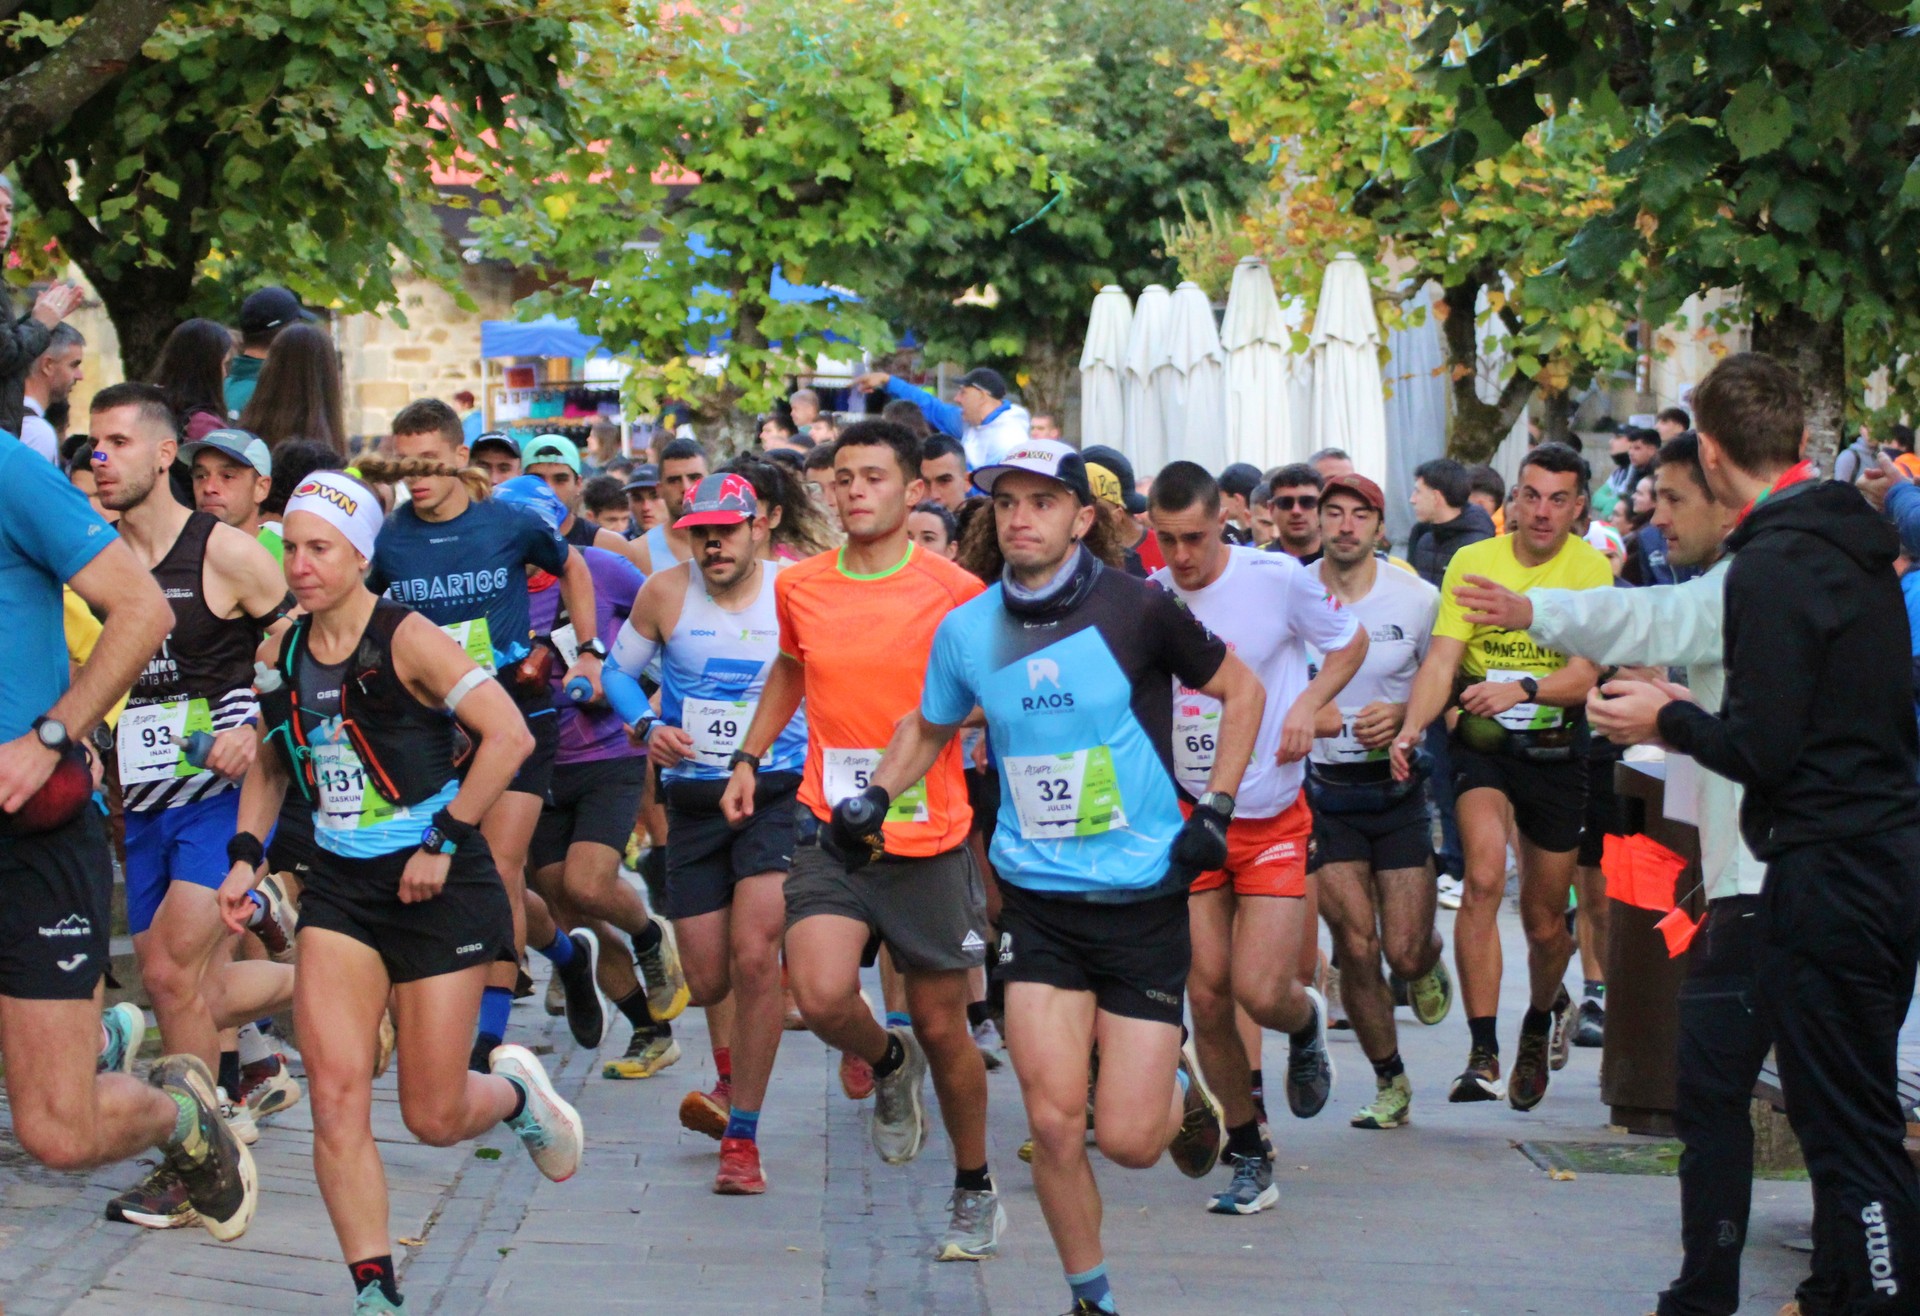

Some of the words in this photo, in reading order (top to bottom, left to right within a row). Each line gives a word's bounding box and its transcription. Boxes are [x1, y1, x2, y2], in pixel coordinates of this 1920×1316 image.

[1022, 693, 1074, 711] RAOS
[142, 726, 172, 748] 93
[708, 720, 738, 738] 49
[1185, 734, 1215, 753] 66
[322, 768, 364, 792] 131
[1036, 778, 1073, 802] 32
[1046, 803, 1072, 812] JULEN
